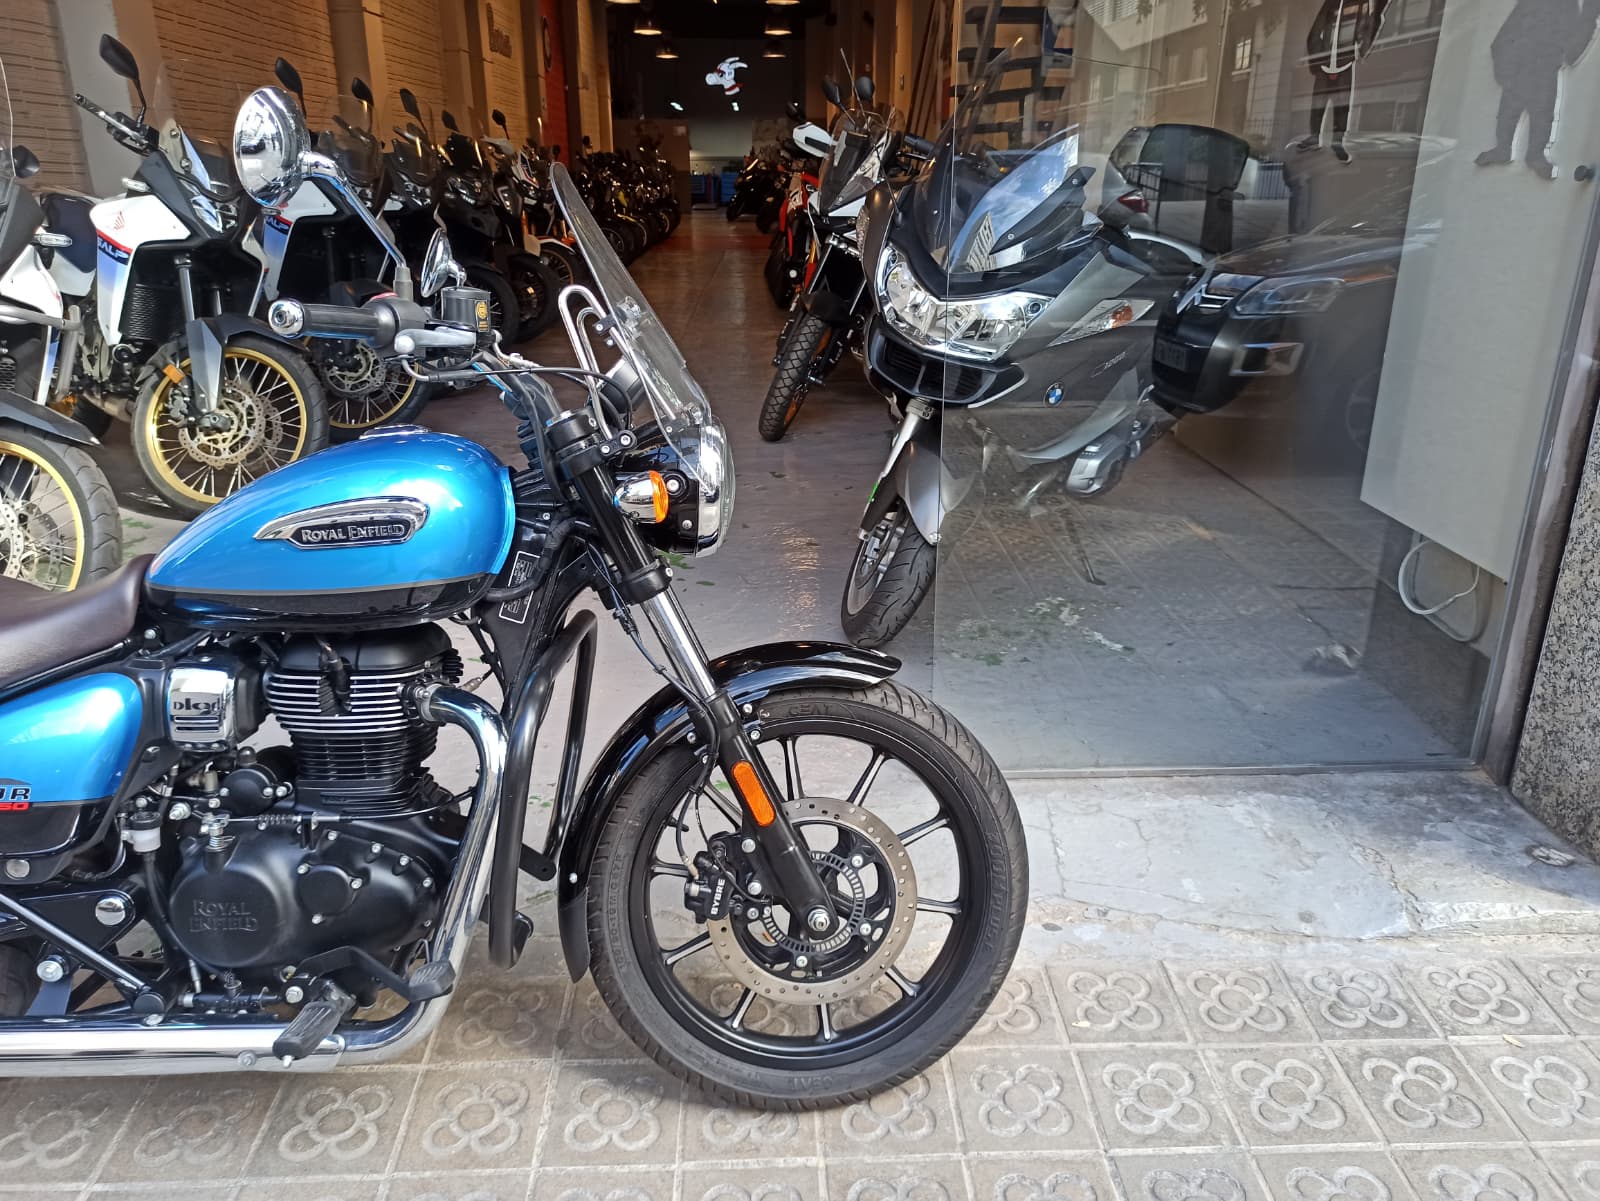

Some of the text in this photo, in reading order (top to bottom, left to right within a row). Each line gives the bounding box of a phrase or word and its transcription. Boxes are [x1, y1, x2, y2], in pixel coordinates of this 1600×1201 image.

[301, 524, 405, 543] ROYAL ENFIELD
[710, 878, 726, 915] BYBRE
[193, 900, 252, 917] ROYAL
[189, 916, 258, 933] ENFIELD
